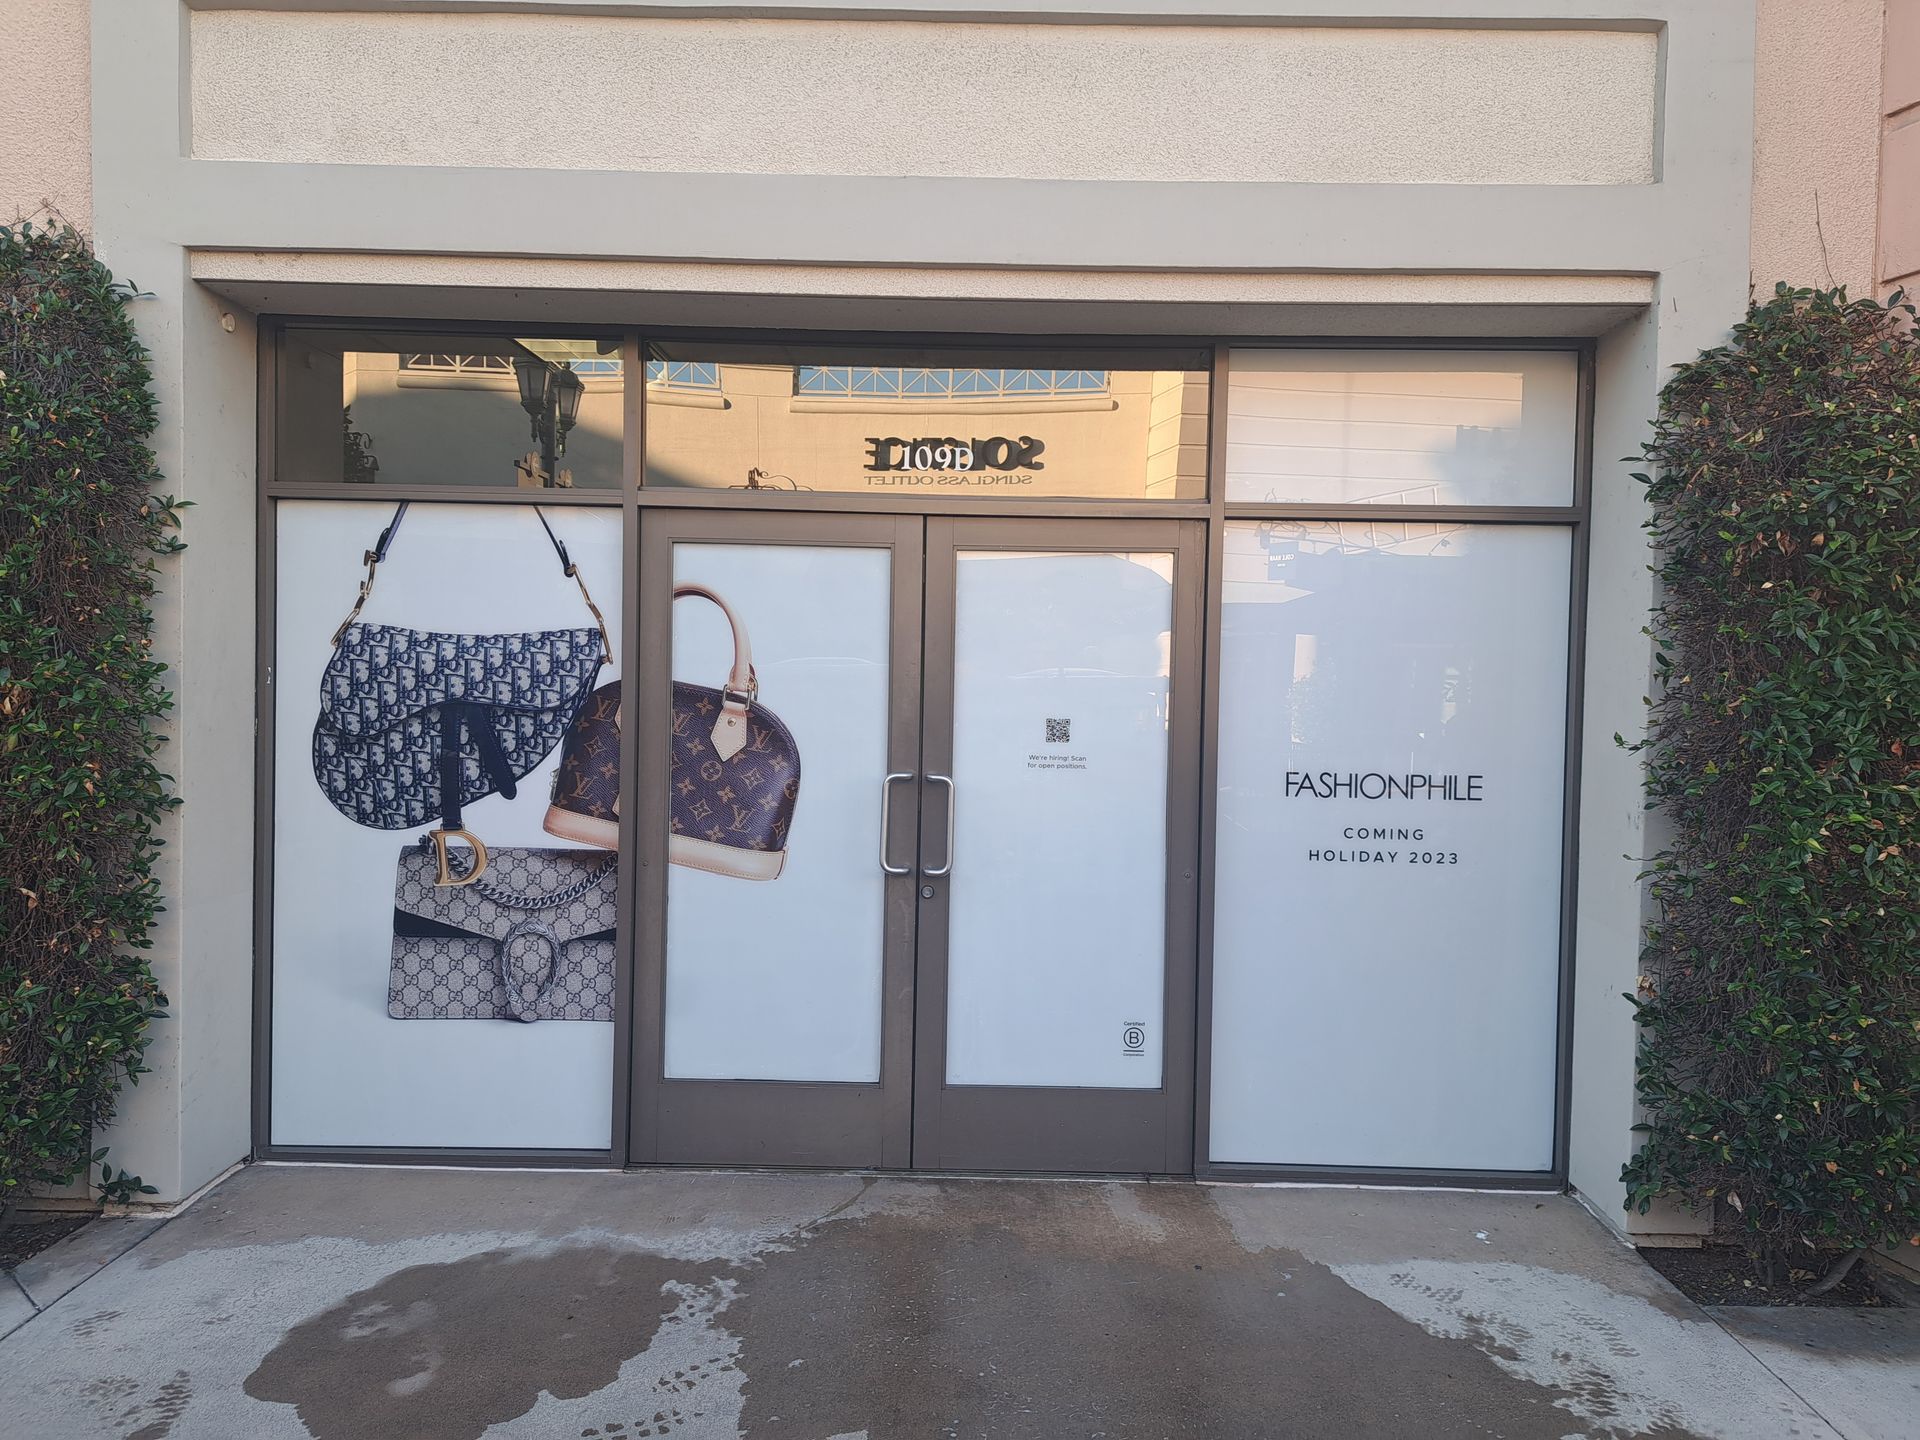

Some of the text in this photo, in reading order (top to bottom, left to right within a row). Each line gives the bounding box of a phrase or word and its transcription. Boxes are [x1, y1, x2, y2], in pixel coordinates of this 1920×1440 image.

[901, 445, 974, 471] 109D
[1285, 771, 1484, 801] FASHIONPHILE
[1343, 827, 1425, 841] COMING
[1308, 849, 1459, 865] HOLIDAY 2023
